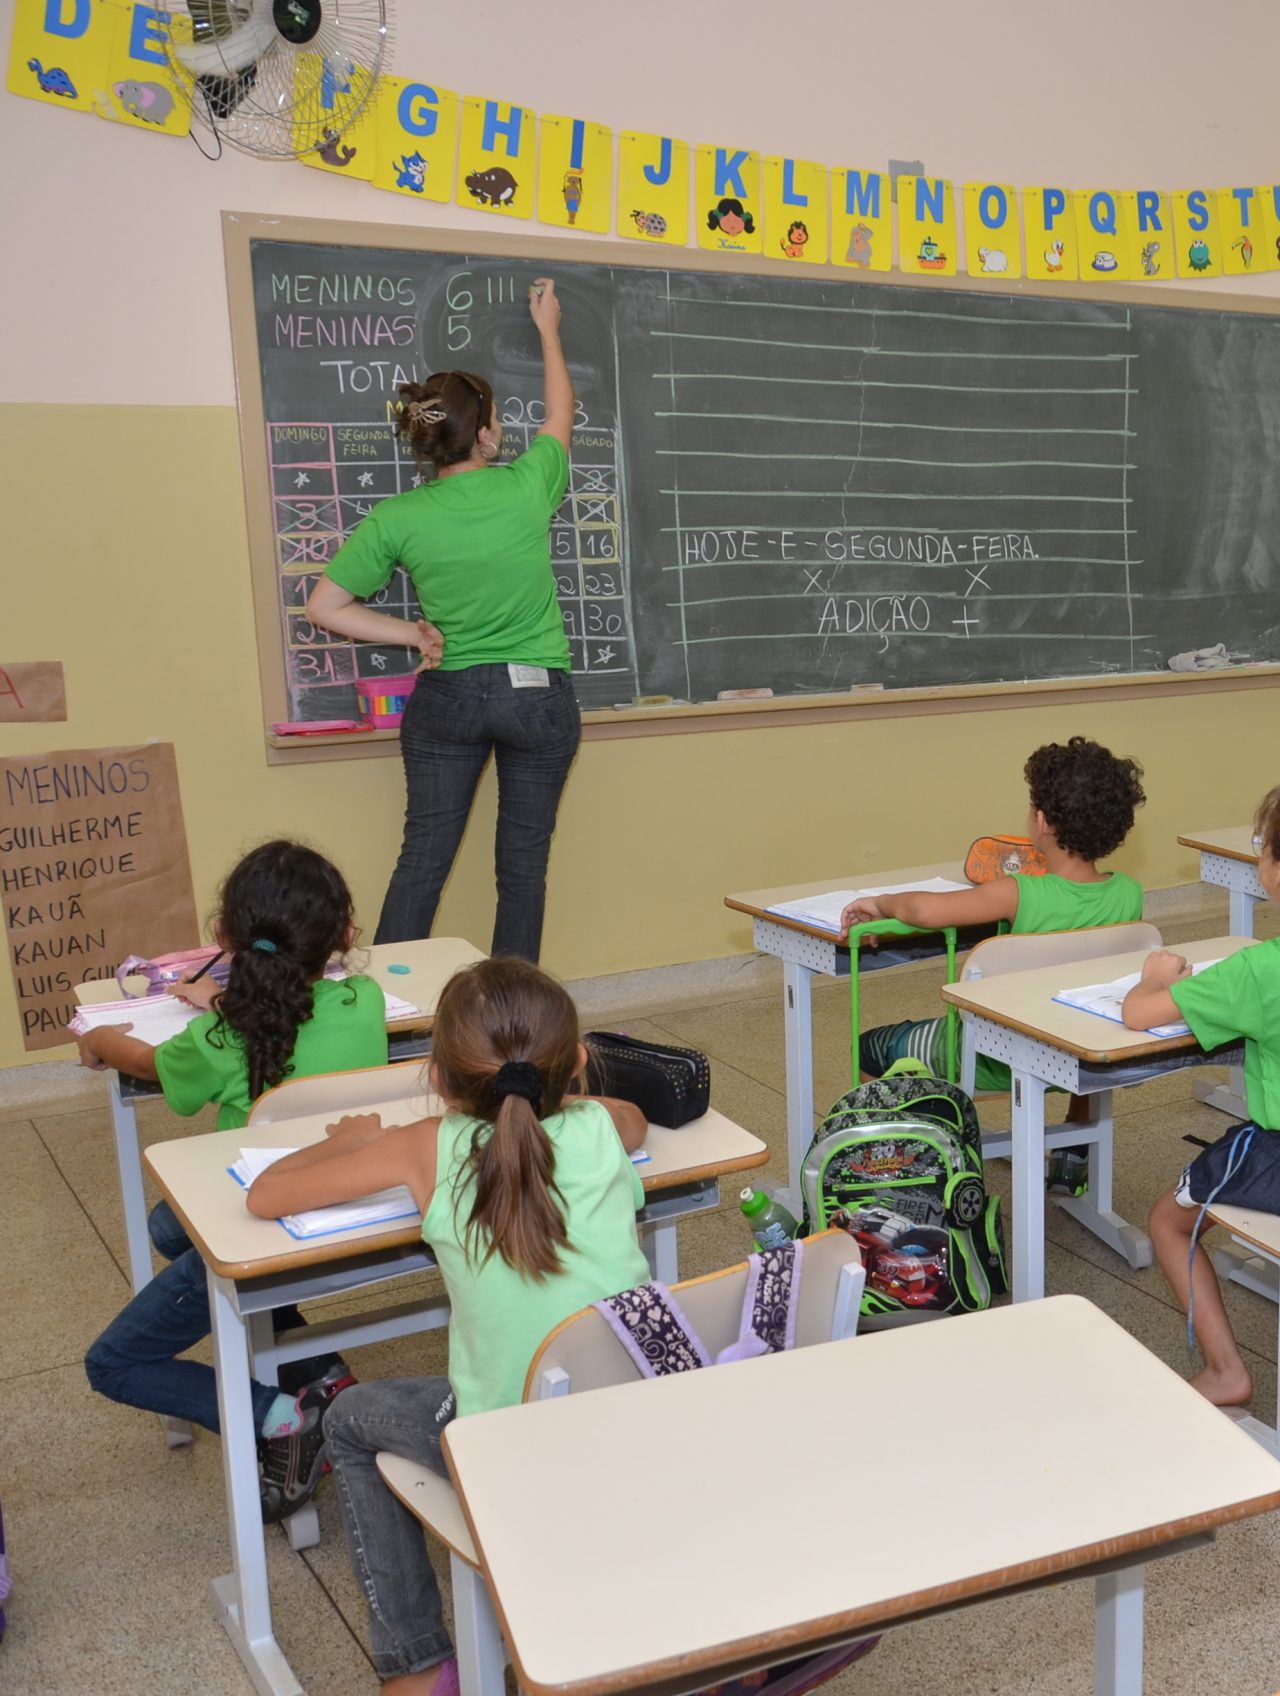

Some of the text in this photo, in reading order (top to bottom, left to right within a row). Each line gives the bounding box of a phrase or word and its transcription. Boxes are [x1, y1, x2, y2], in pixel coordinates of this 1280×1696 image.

[43, 0, 91, 38] D
[127, 4, 168, 66] E
[397, 84, 439, 137] G
[481, 101, 523, 157] H
[570, 119, 586, 169] I
[643, 137, 672, 185] J
[714, 148, 749, 198] K
[782, 159, 808, 207] L
[846, 169, 881, 218] M
[915, 177, 944, 224] N
[978, 185, 1007, 229] O
[1042, 188, 1065, 230] P
[1088, 191, 1117, 236] Q
[1136, 190, 1163, 232] R
[1187, 190, 1210, 231] S
[1232, 187, 1255, 227] T
[271, 273, 416, 307] MENINOS
[446, 272, 473, 311] 6
[275, 313, 472, 351] MENINAS 5
[501, 397, 588, 427] 203
[274, 428, 328, 444] DOMINGO
[337, 429, 391, 441] SEGUNDA
[343, 445, 377, 456] FEIRA
[573, 434, 613, 448] SÁBADO
[587, 535, 613, 557] 16
[585, 573, 616, 596] 23
[589, 604, 621, 634] 30
[818, 594, 930, 653] ADIÇÃO
[298, 651, 335, 682] 31
[6, 760, 150, 806] MENINOS
[0, 812, 143, 852] GUILHERME
[1, 852, 136, 892] HENRIQUE
[9, 893, 85, 928] KAUÃ
[14, 929, 105, 966] KAUAN
[18, 972, 71, 998] LUIS
